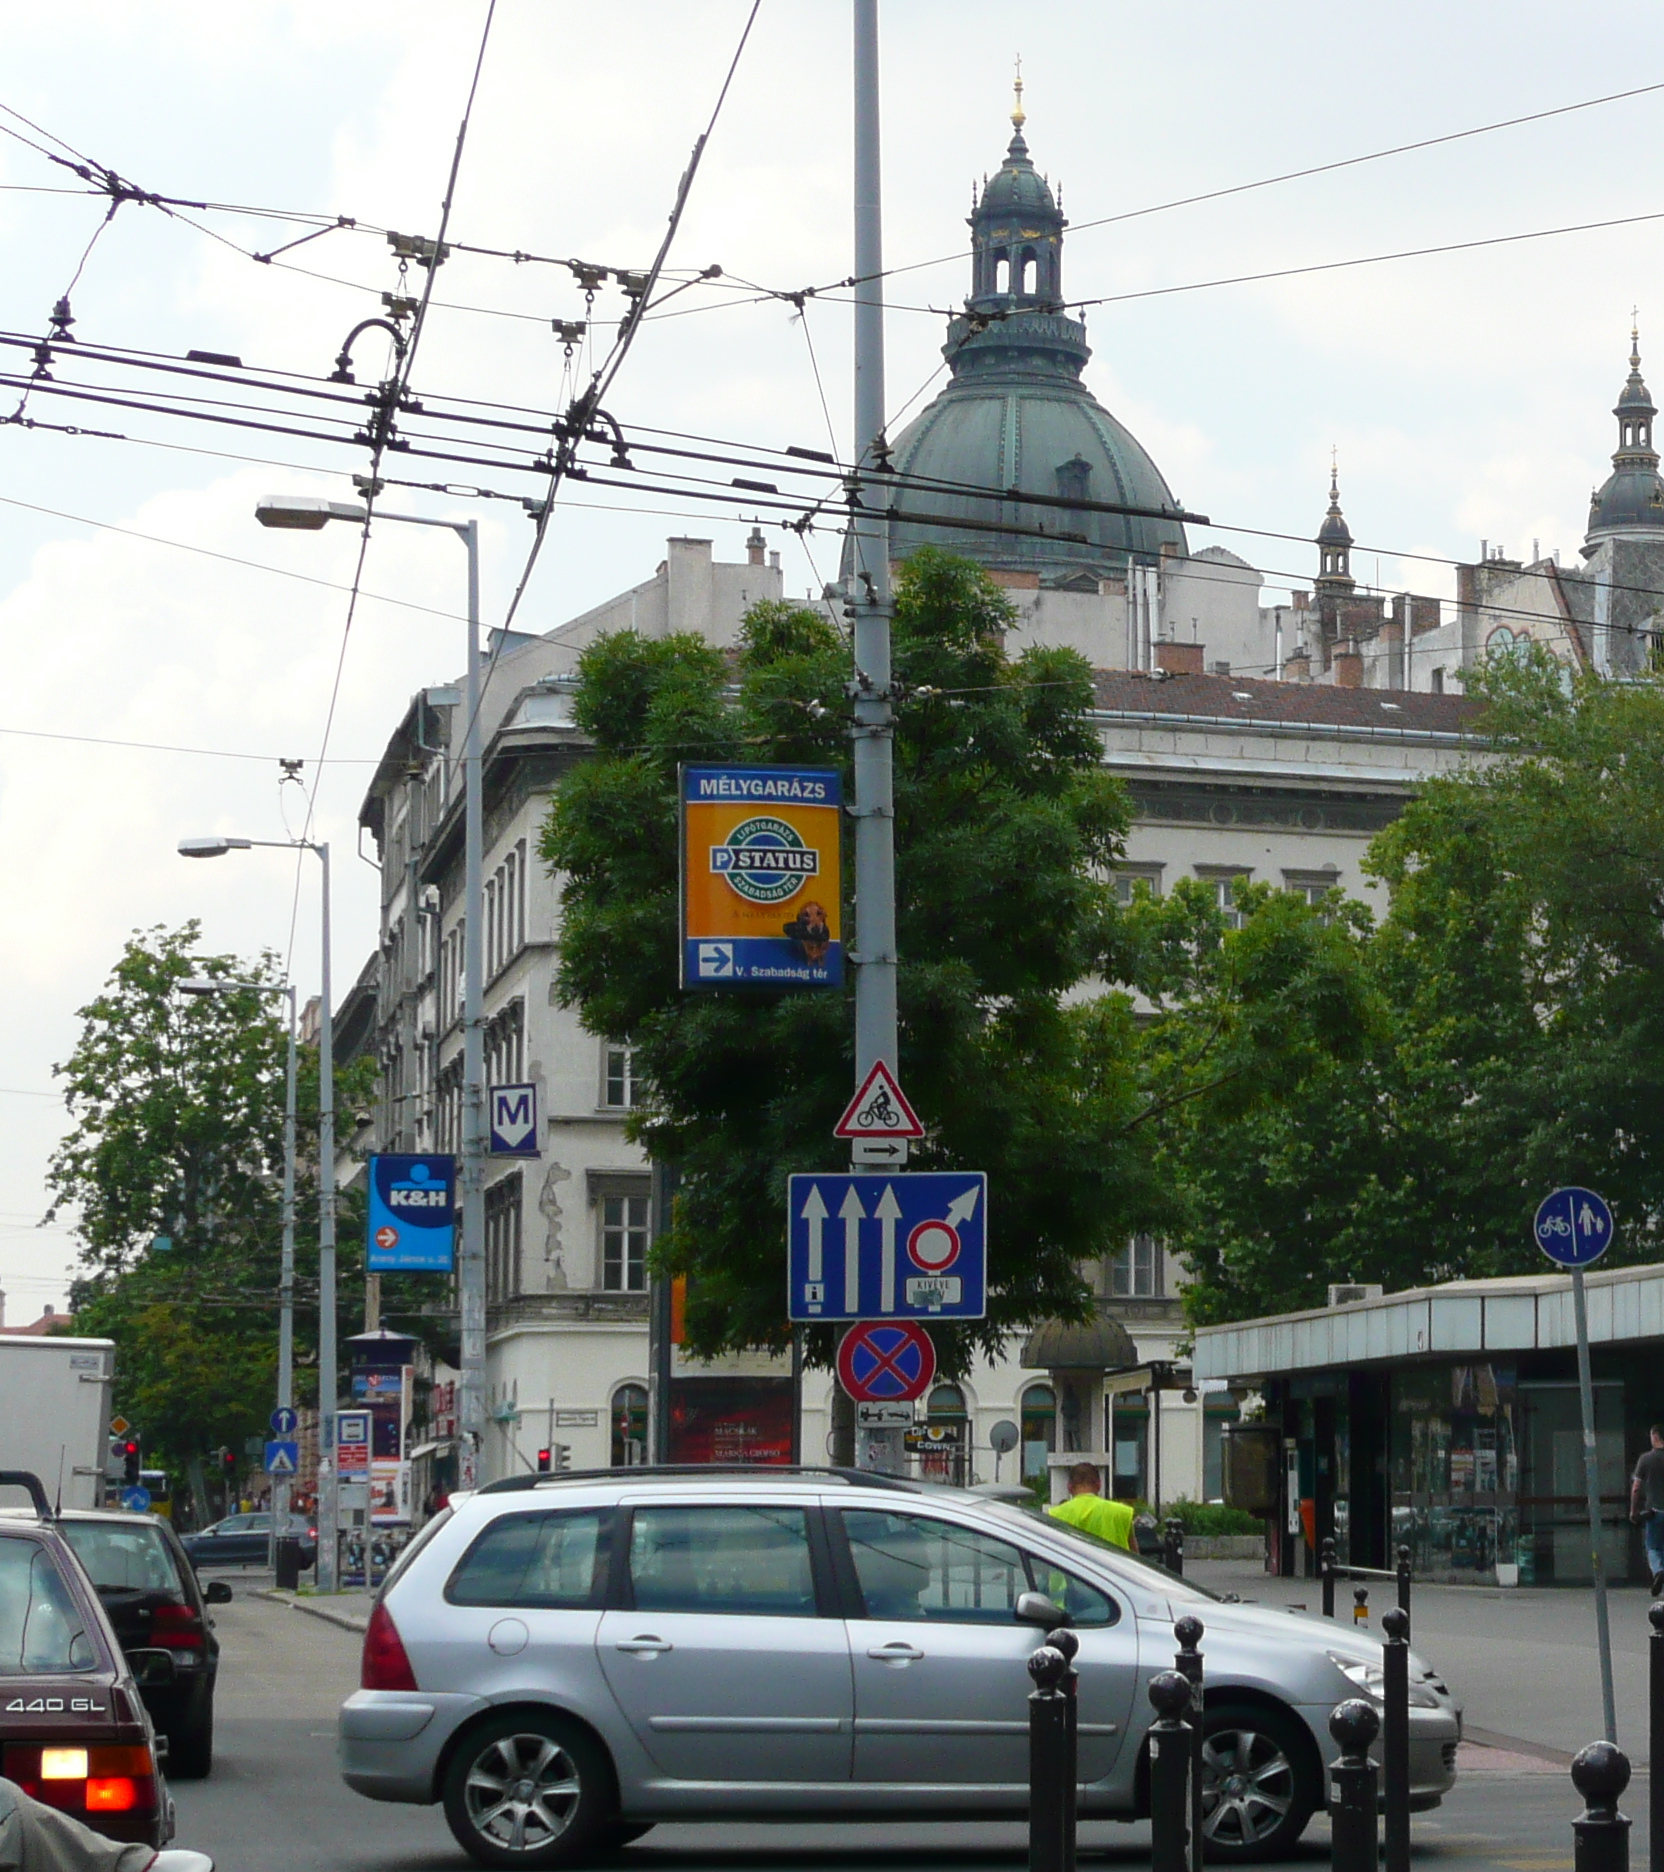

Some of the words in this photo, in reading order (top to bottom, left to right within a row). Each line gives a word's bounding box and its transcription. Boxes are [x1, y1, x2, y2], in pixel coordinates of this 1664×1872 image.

[699, 774, 826, 799] MÉLYGARÁZS
[738, 852, 815, 871] STATUS
[751, 966, 811, 980] Szabadság
[812, 967, 828, 979] tér
[390, 1189, 447, 1207] K&H
[5, 1698, 46, 1713] 440
[71, 1698, 106, 1712] GL
